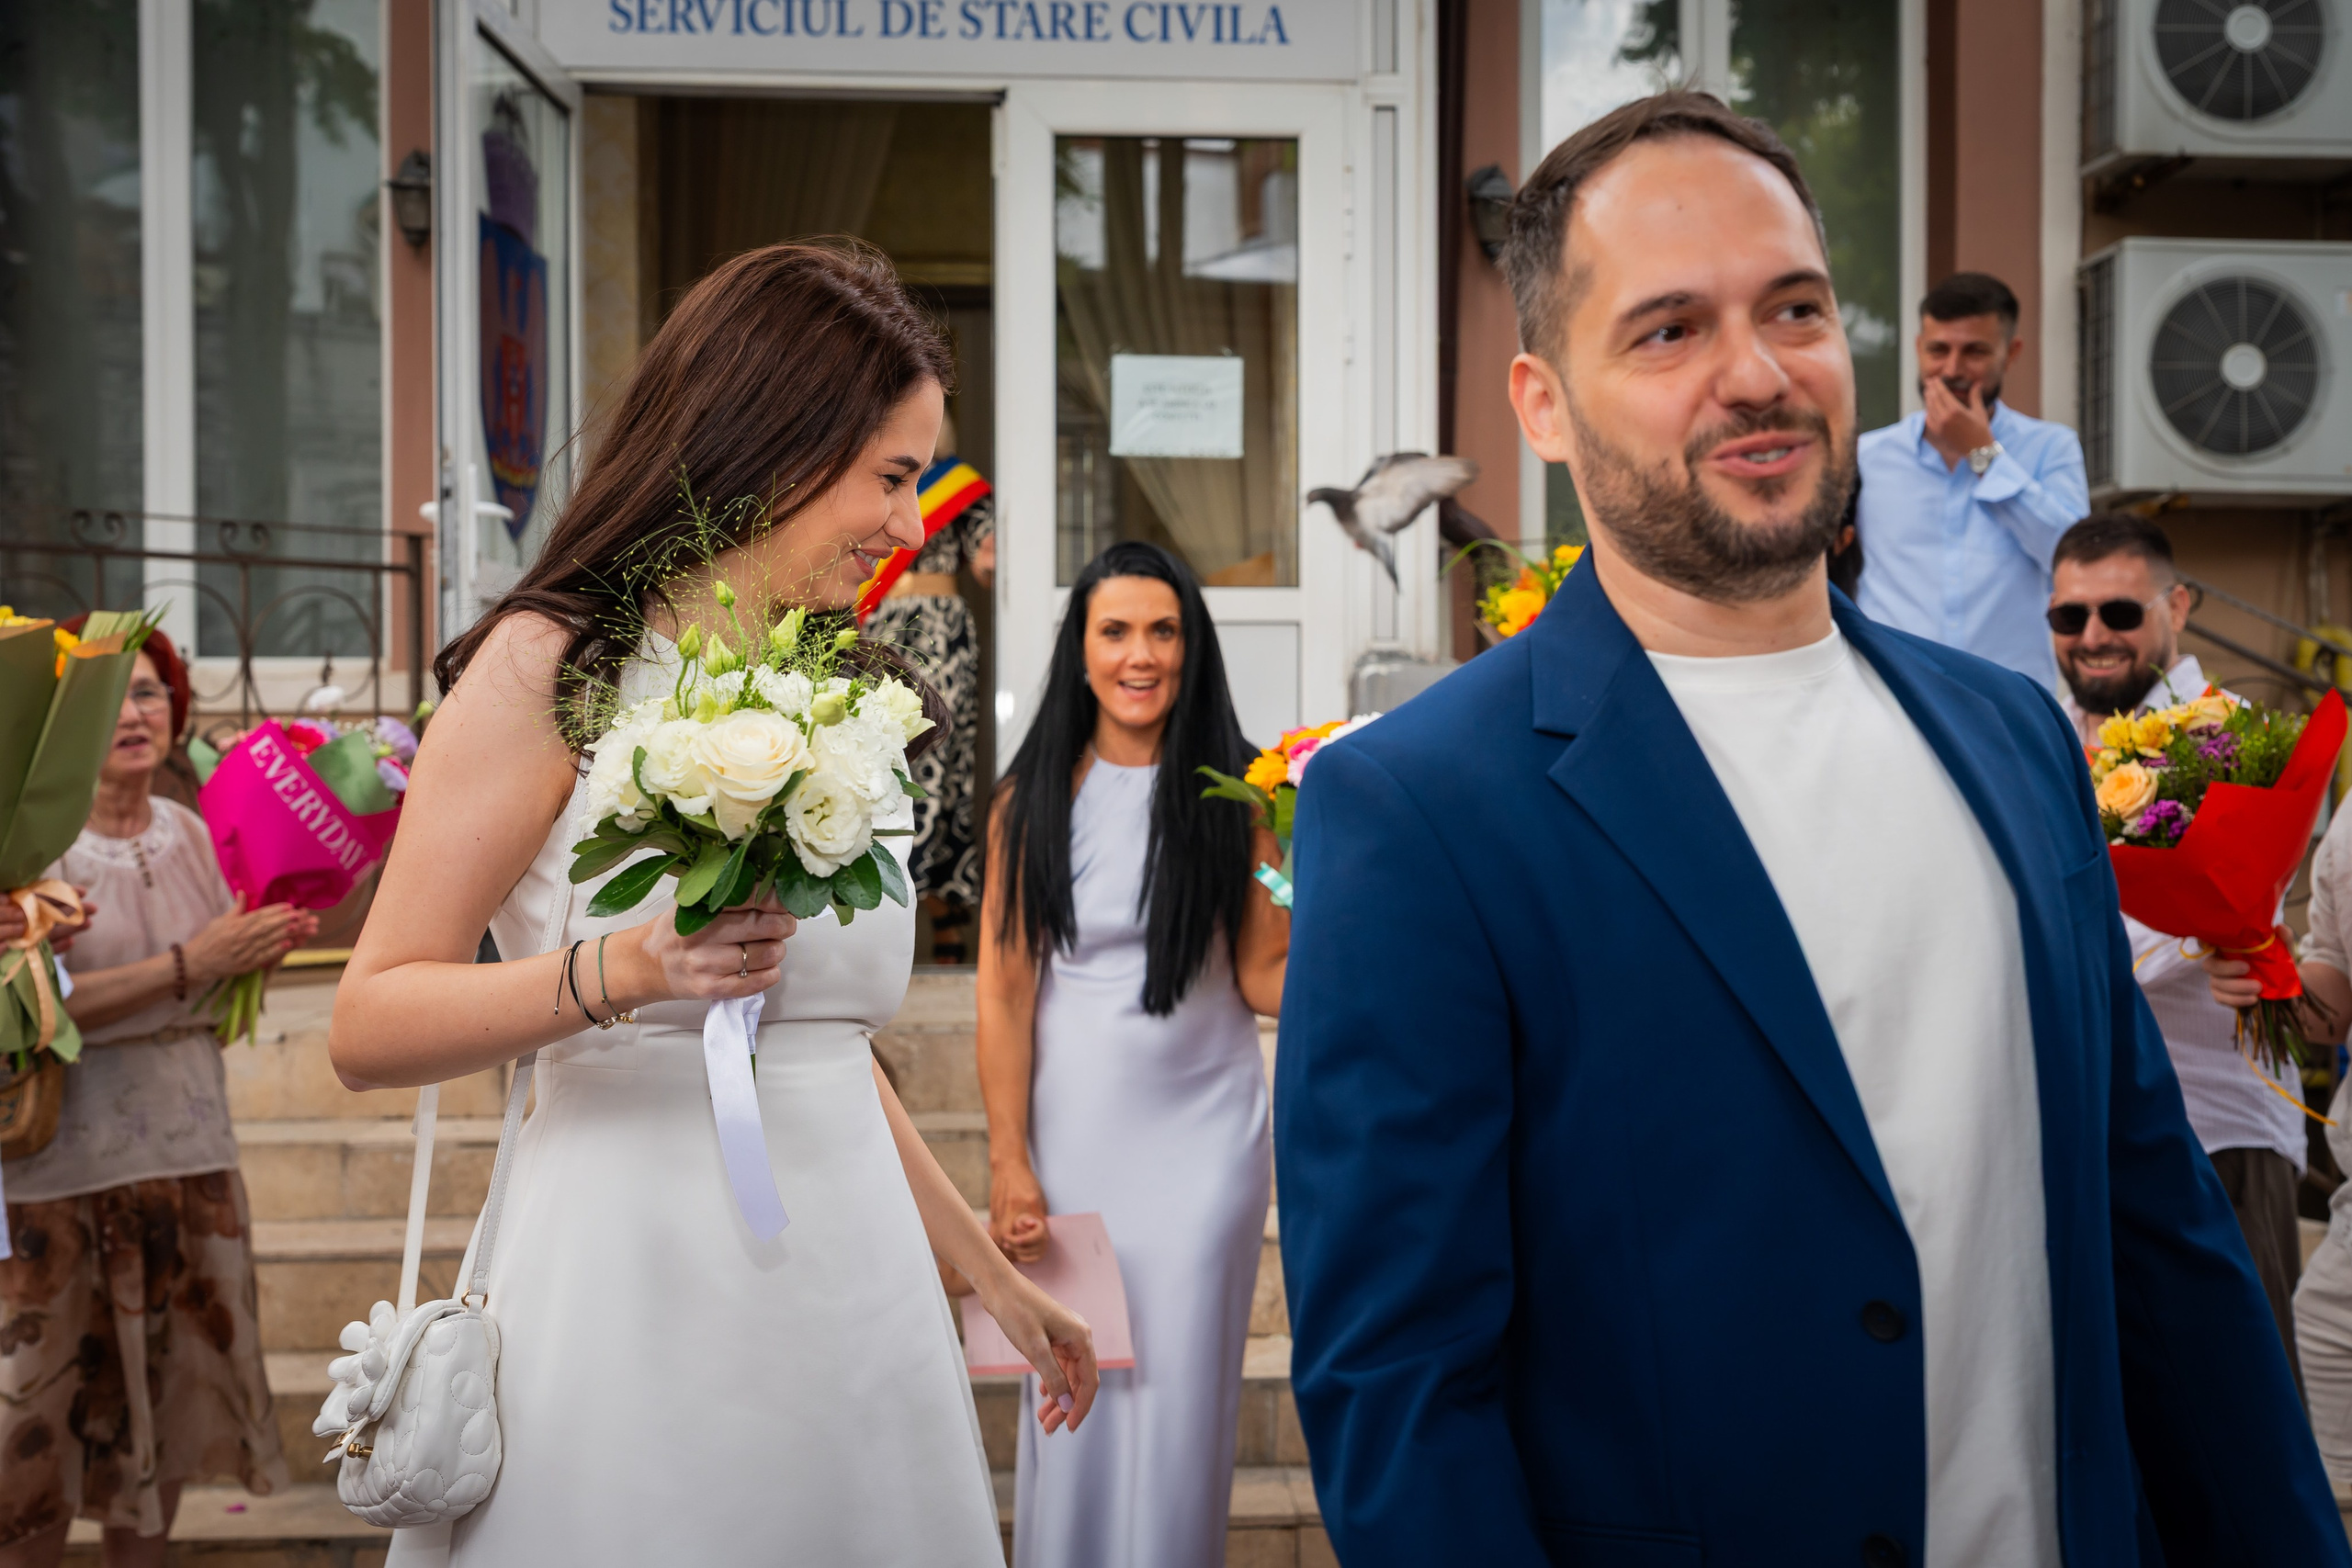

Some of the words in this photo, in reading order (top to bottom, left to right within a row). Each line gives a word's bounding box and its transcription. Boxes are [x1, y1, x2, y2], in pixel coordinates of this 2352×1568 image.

[608, 0, 865, 37] SERVICIUL
[879, 0, 946, 39] DE
[958, 0, 1112, 42] STARE
[1123, 2, 1291, 45] CIVILA
